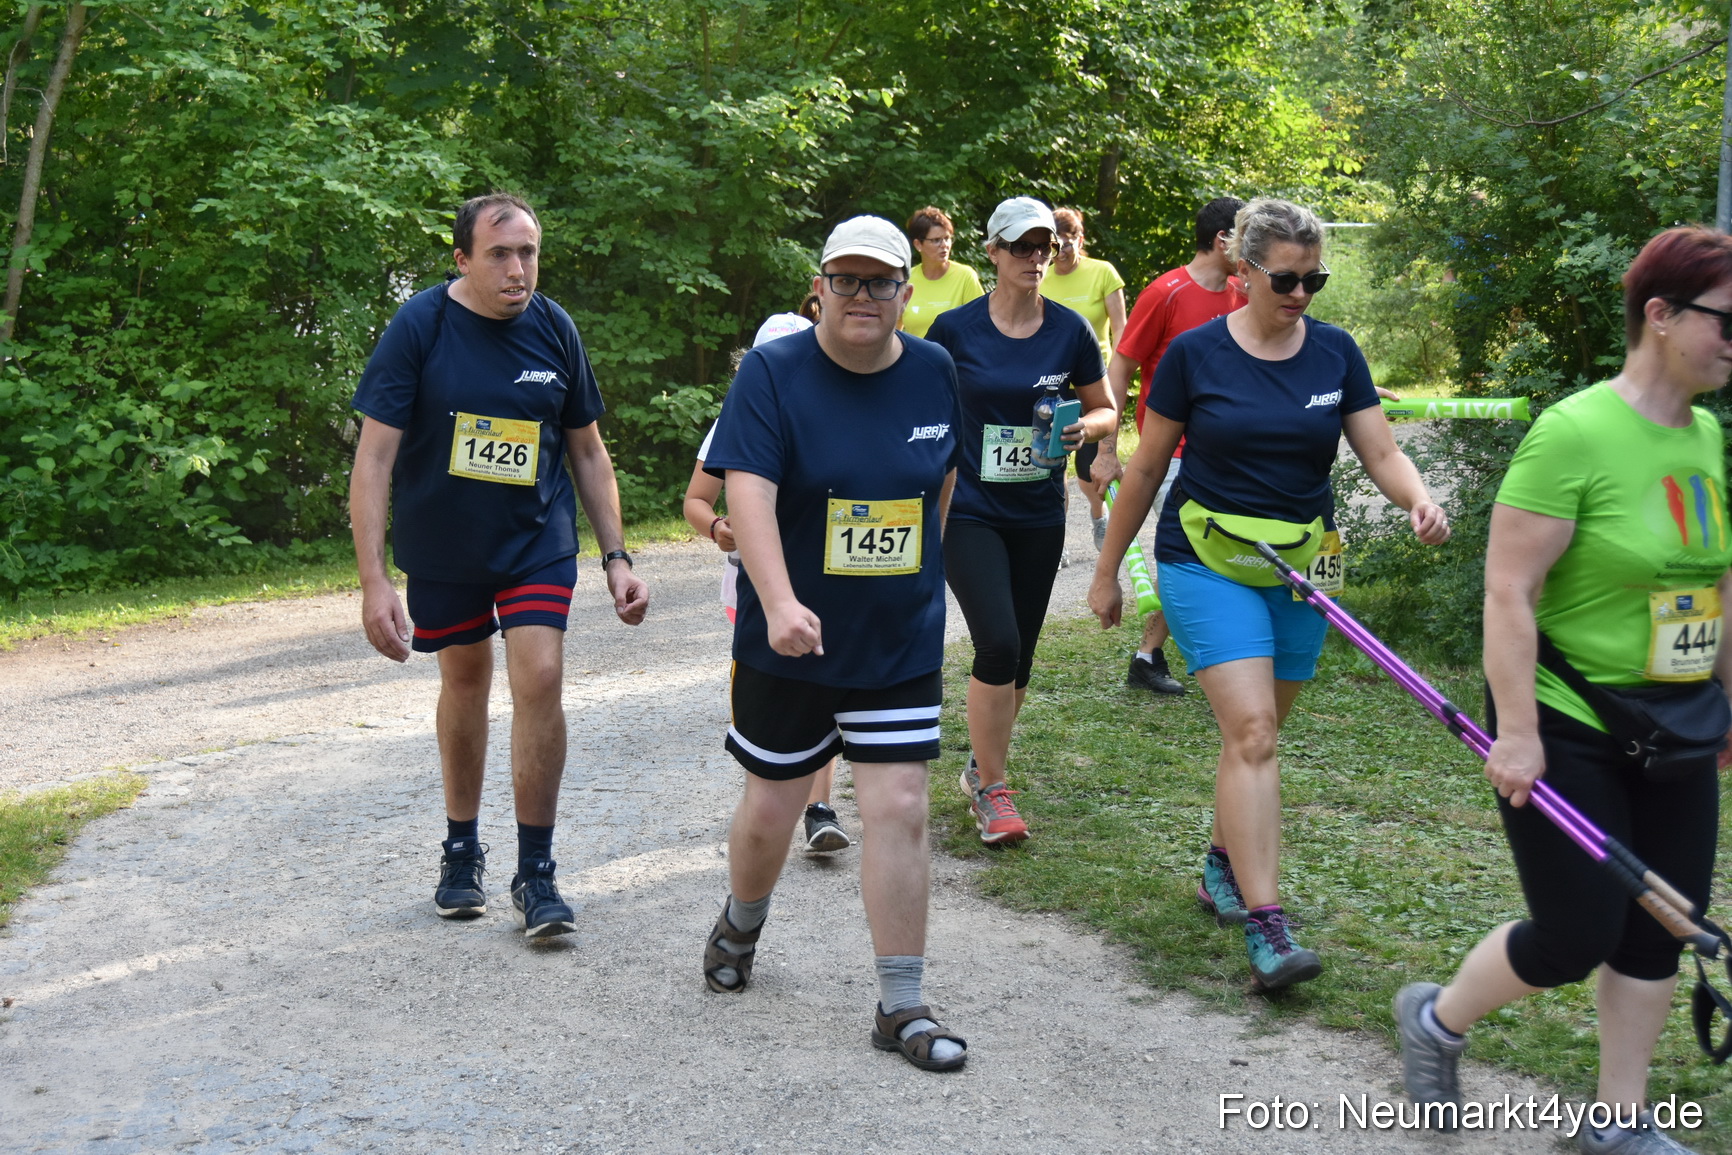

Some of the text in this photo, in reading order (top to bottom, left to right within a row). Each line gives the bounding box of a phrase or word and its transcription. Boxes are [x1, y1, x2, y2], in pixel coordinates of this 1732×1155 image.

[465, 437, 528, 467] 1426
[992, 446, 1032, 467] 143
[468, 461, 520, 474] Neuner Thomas
[840, 526, 912, 555] 1457
[849, 555, 874, 563] Walter
